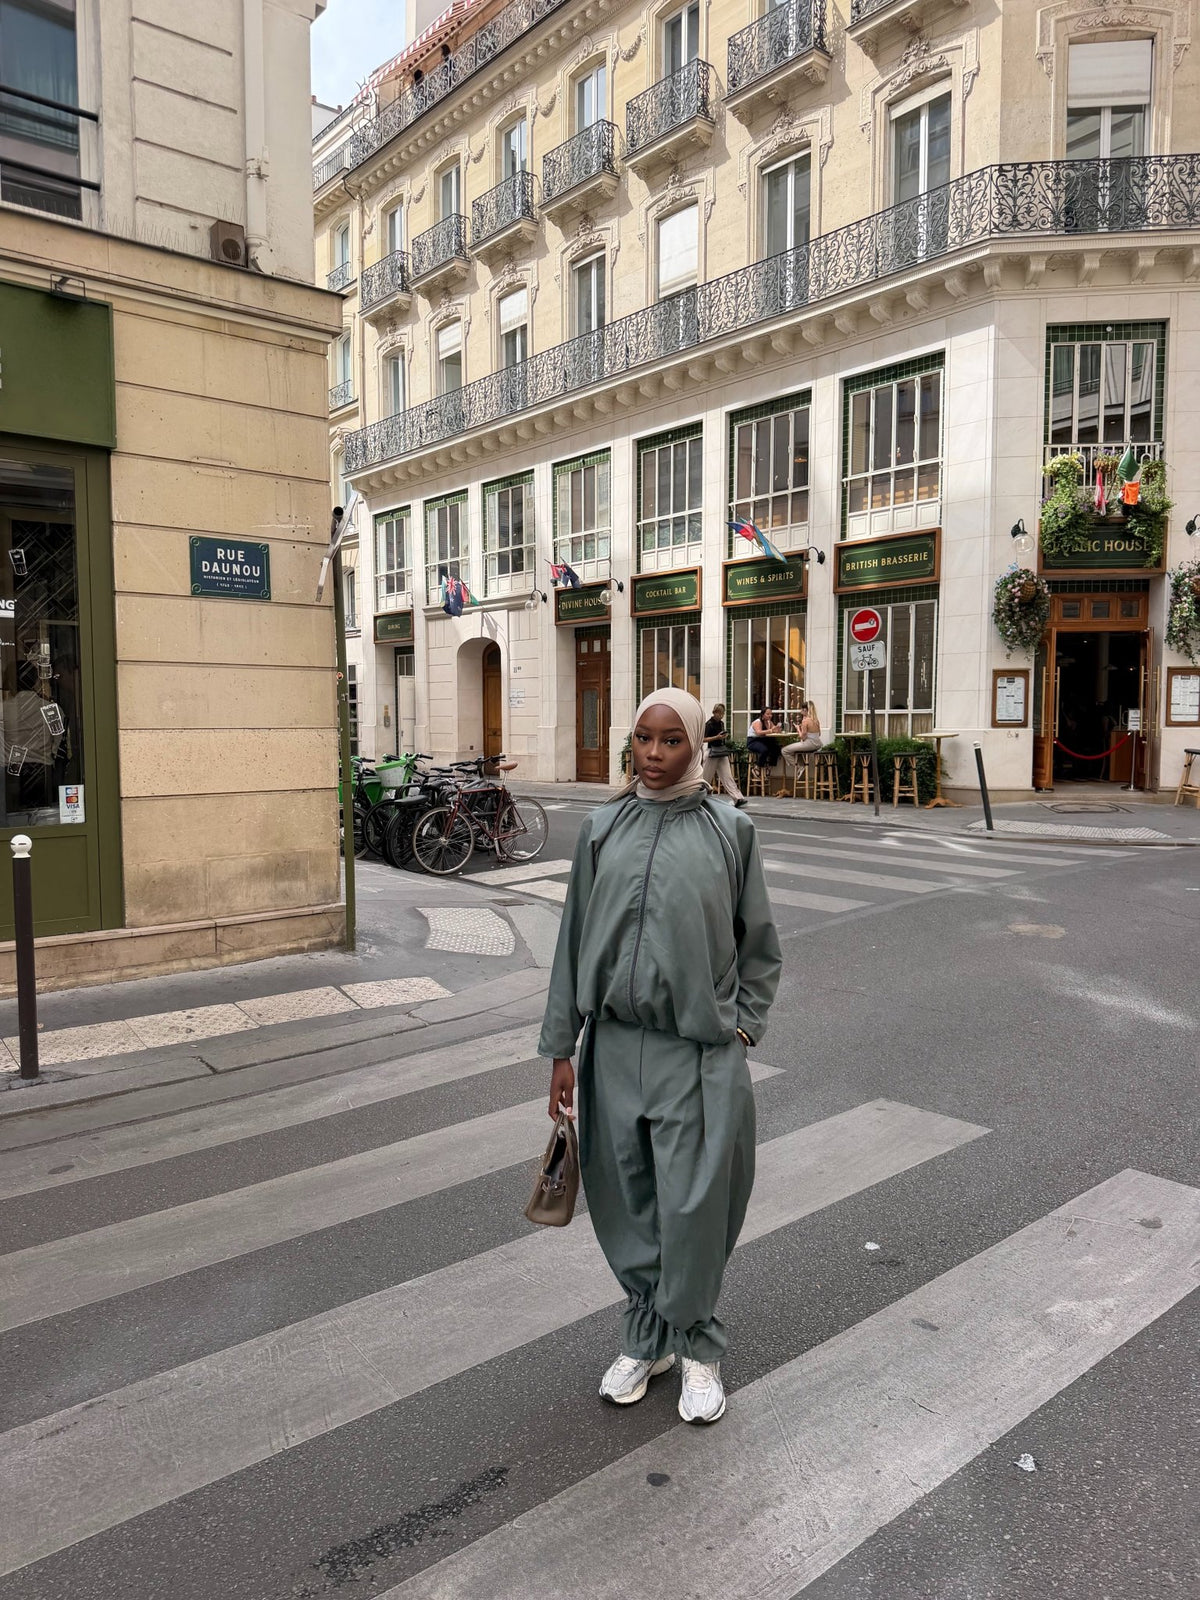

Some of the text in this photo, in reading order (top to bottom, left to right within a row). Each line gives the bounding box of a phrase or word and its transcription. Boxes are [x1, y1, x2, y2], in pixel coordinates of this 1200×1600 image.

[217, 548, 245, 562] RUE
[845, 551, 928, 571] BRITISH BRASSERIE
[201, 560, 260, 577] DAUNOU
[736, 576, 758, 586] WINES
[767, 571, 794, 582] SPIRITS
[645, 586, 687, 599] COCKTAIL BAR
[561, 596, 604, 610] DIVINE HOUS
[857, 644, 876, 653] SAUF
